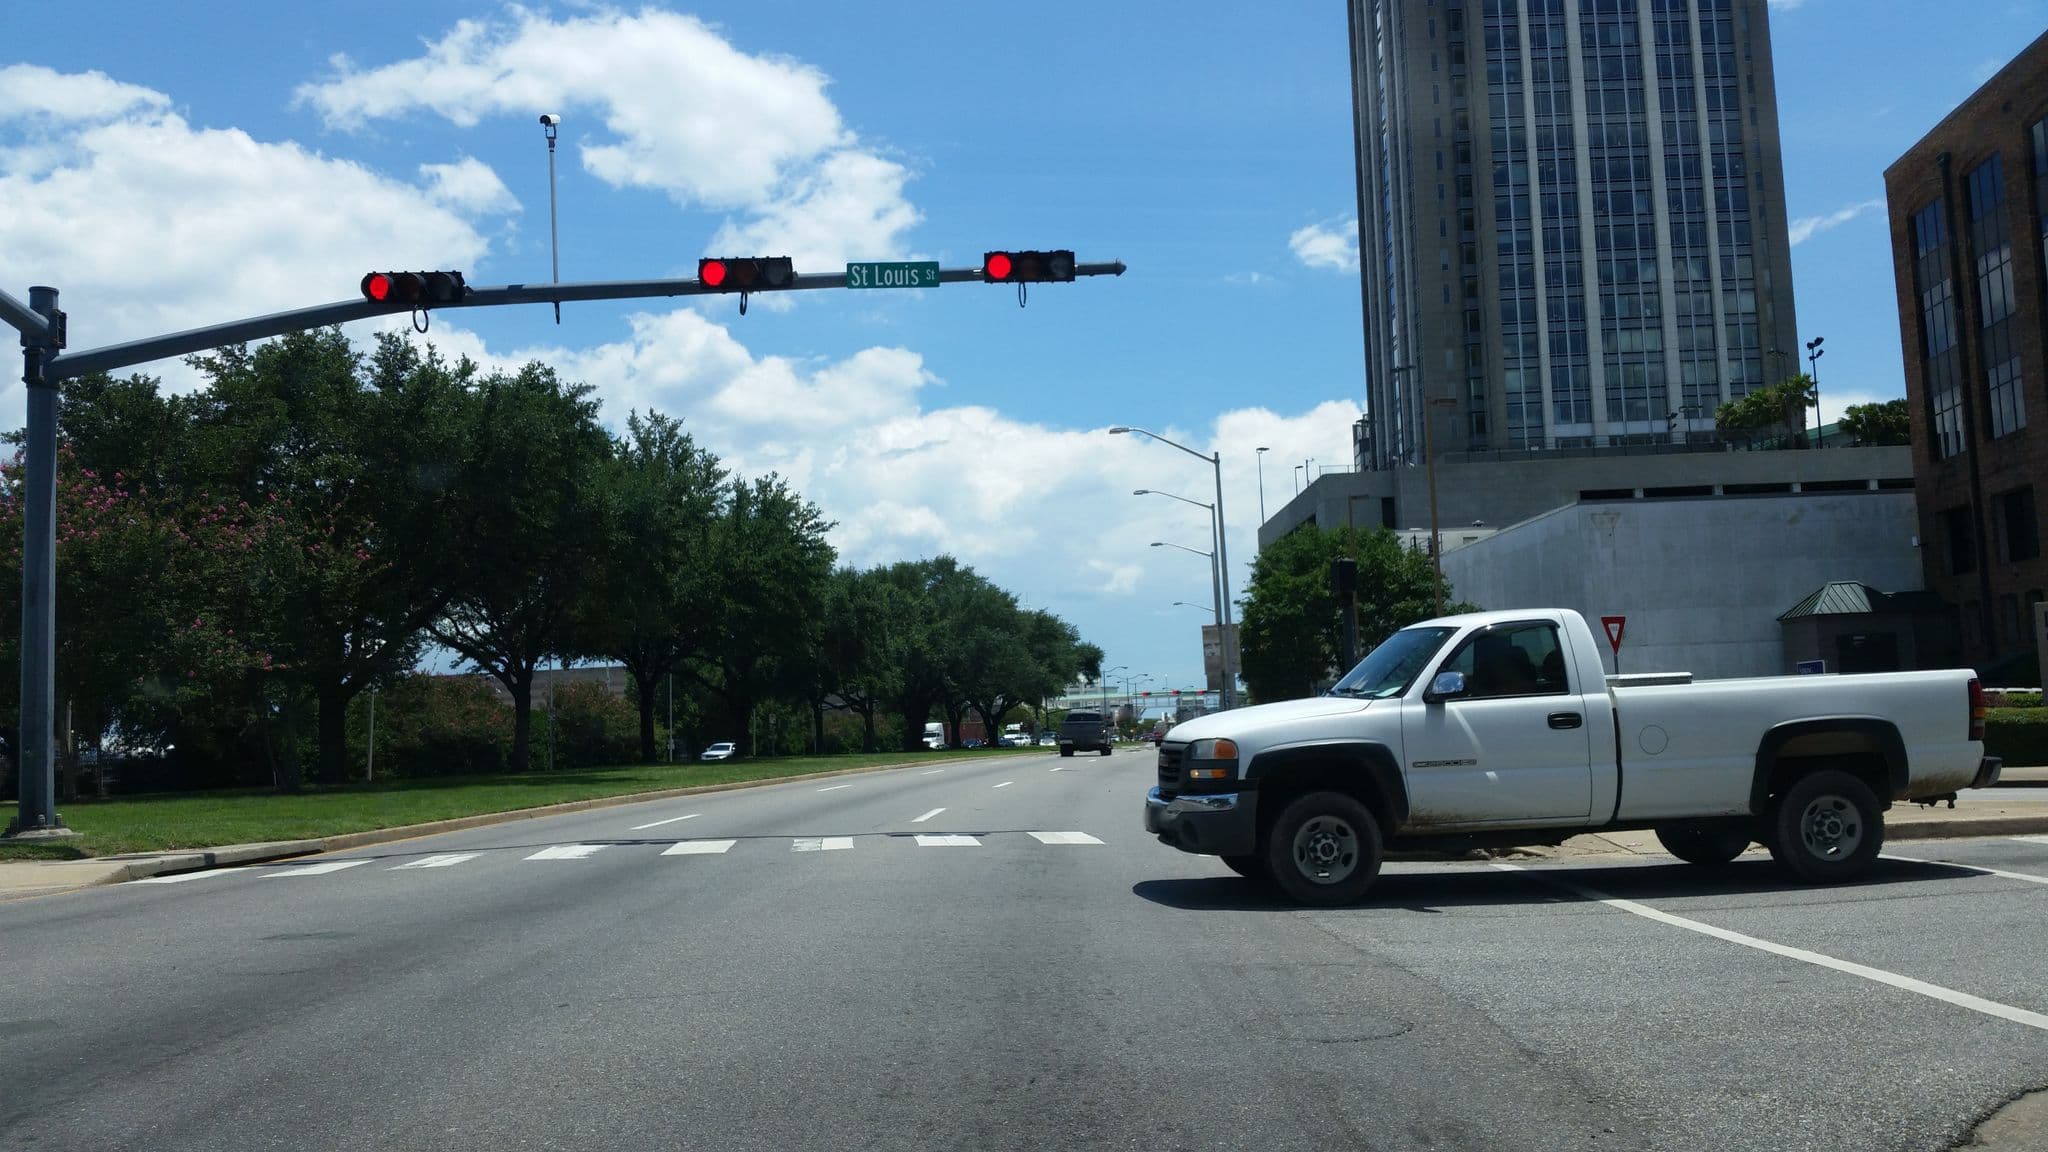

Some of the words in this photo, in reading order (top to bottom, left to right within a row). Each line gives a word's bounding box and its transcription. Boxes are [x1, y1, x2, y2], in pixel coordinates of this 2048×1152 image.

[851, 265, 868, 286] St
[875, 265, 919, 286] Louis
[926, 269, 935, 280] St
